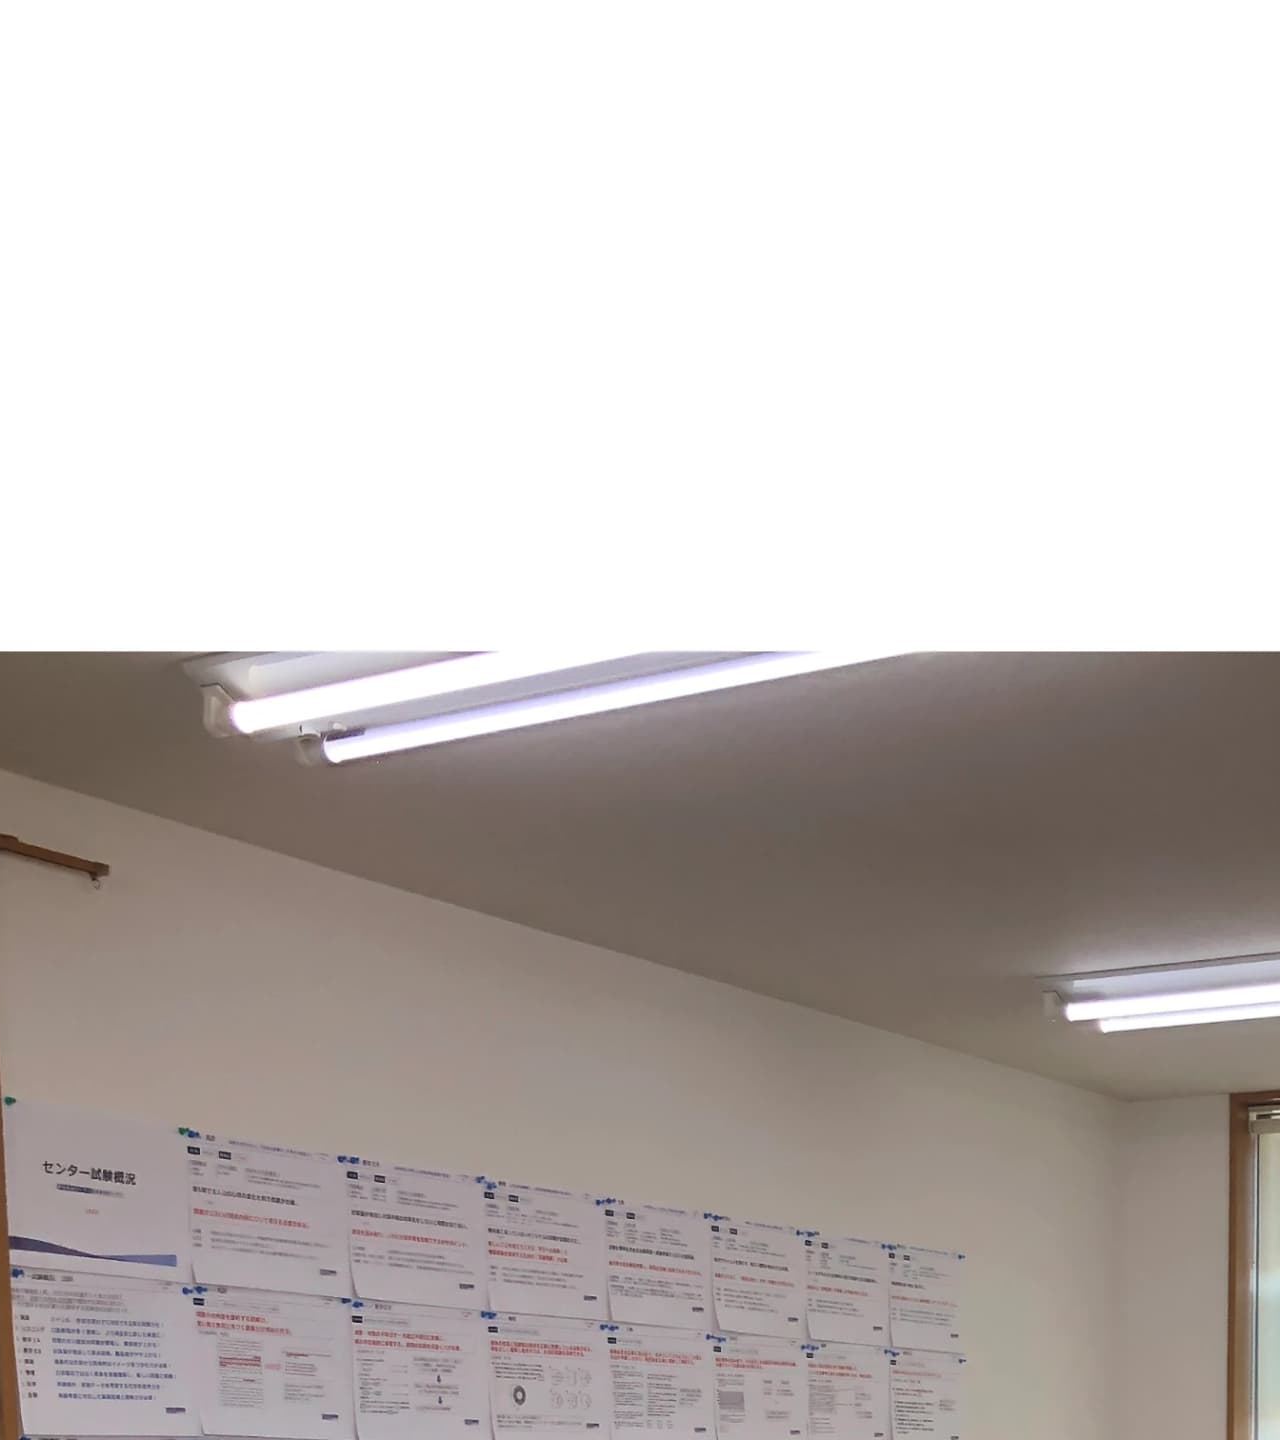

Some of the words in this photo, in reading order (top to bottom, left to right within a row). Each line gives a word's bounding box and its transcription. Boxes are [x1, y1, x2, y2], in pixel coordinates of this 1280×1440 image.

[42, 1160, 137, 1186] センター試験概況
